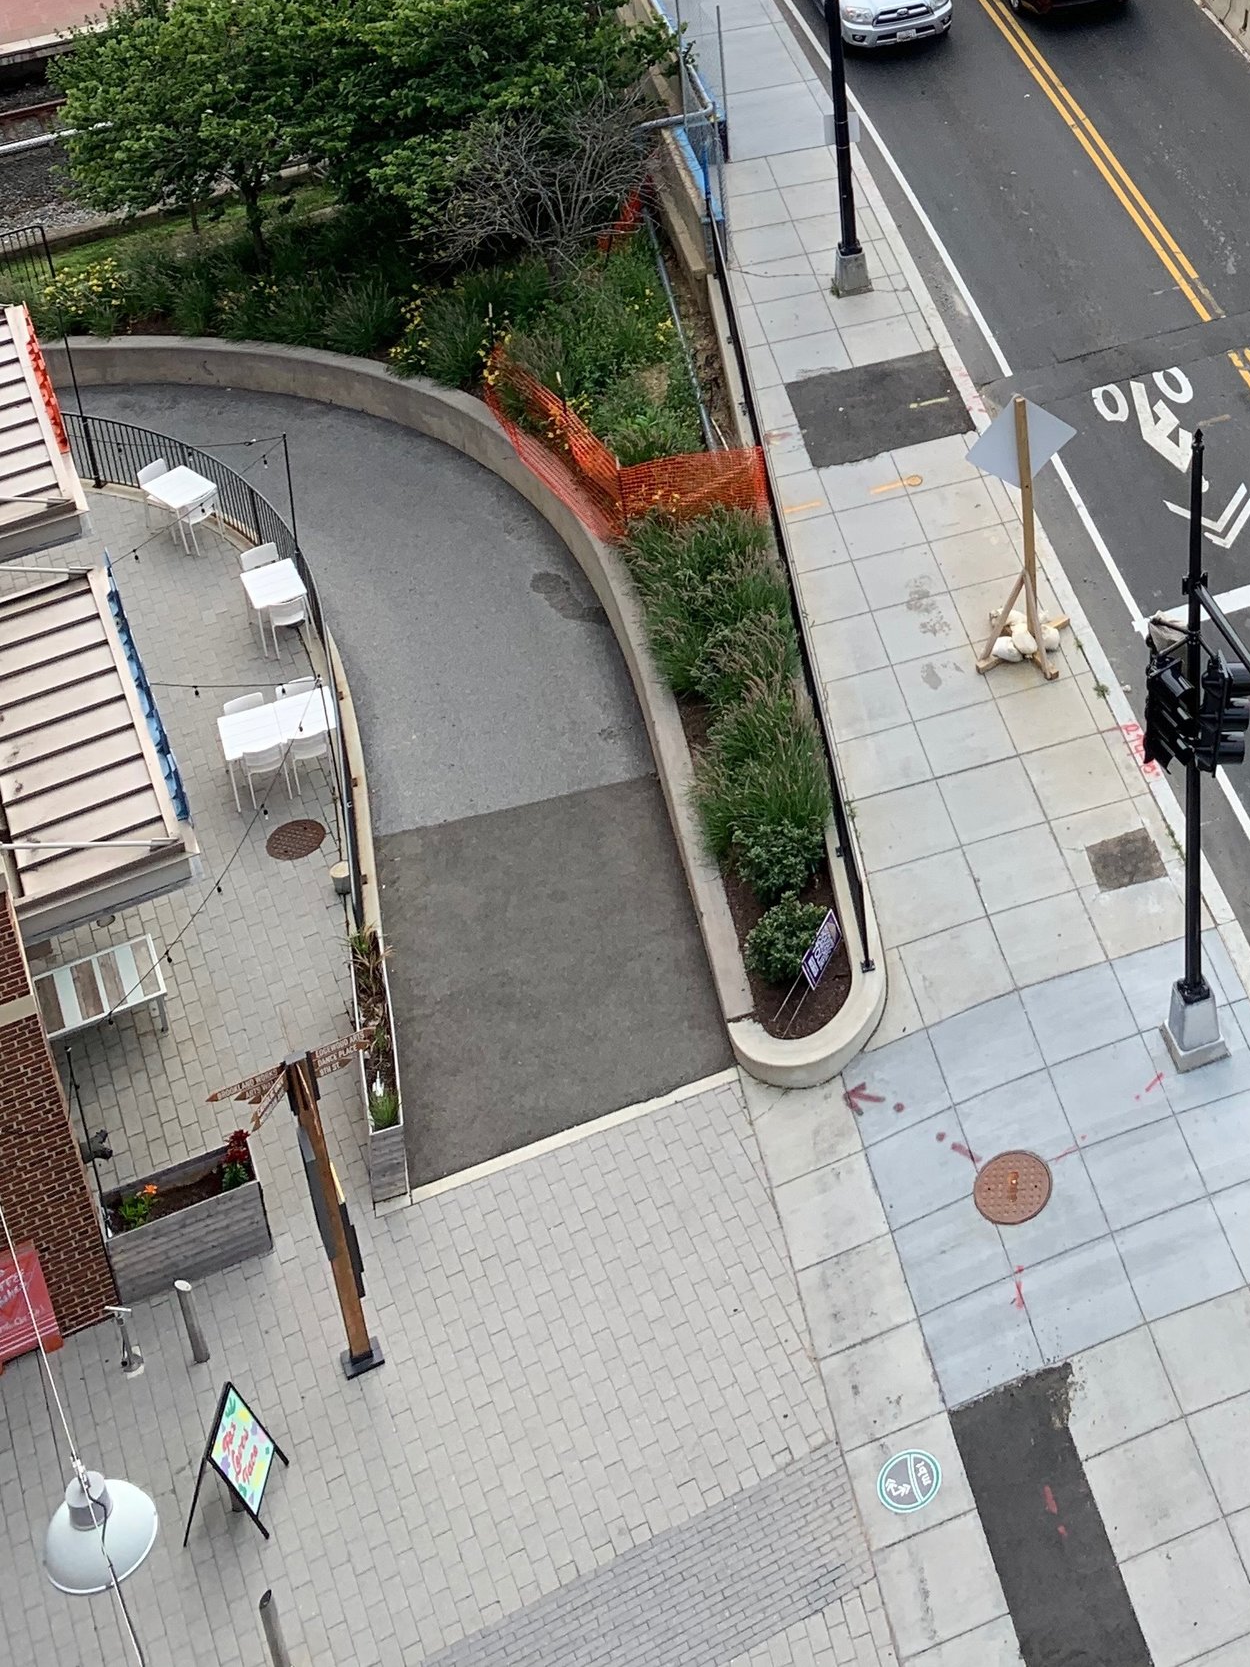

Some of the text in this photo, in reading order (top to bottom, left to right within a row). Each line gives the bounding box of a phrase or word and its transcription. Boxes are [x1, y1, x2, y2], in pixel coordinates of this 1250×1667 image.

[315, 1030, 365, 1058] EDGEWOOD ARTS
[318, 1044, 358, 1068] DANCE PLACE
[217, 1068, 278, 1099] BROOKLAND WORKS
